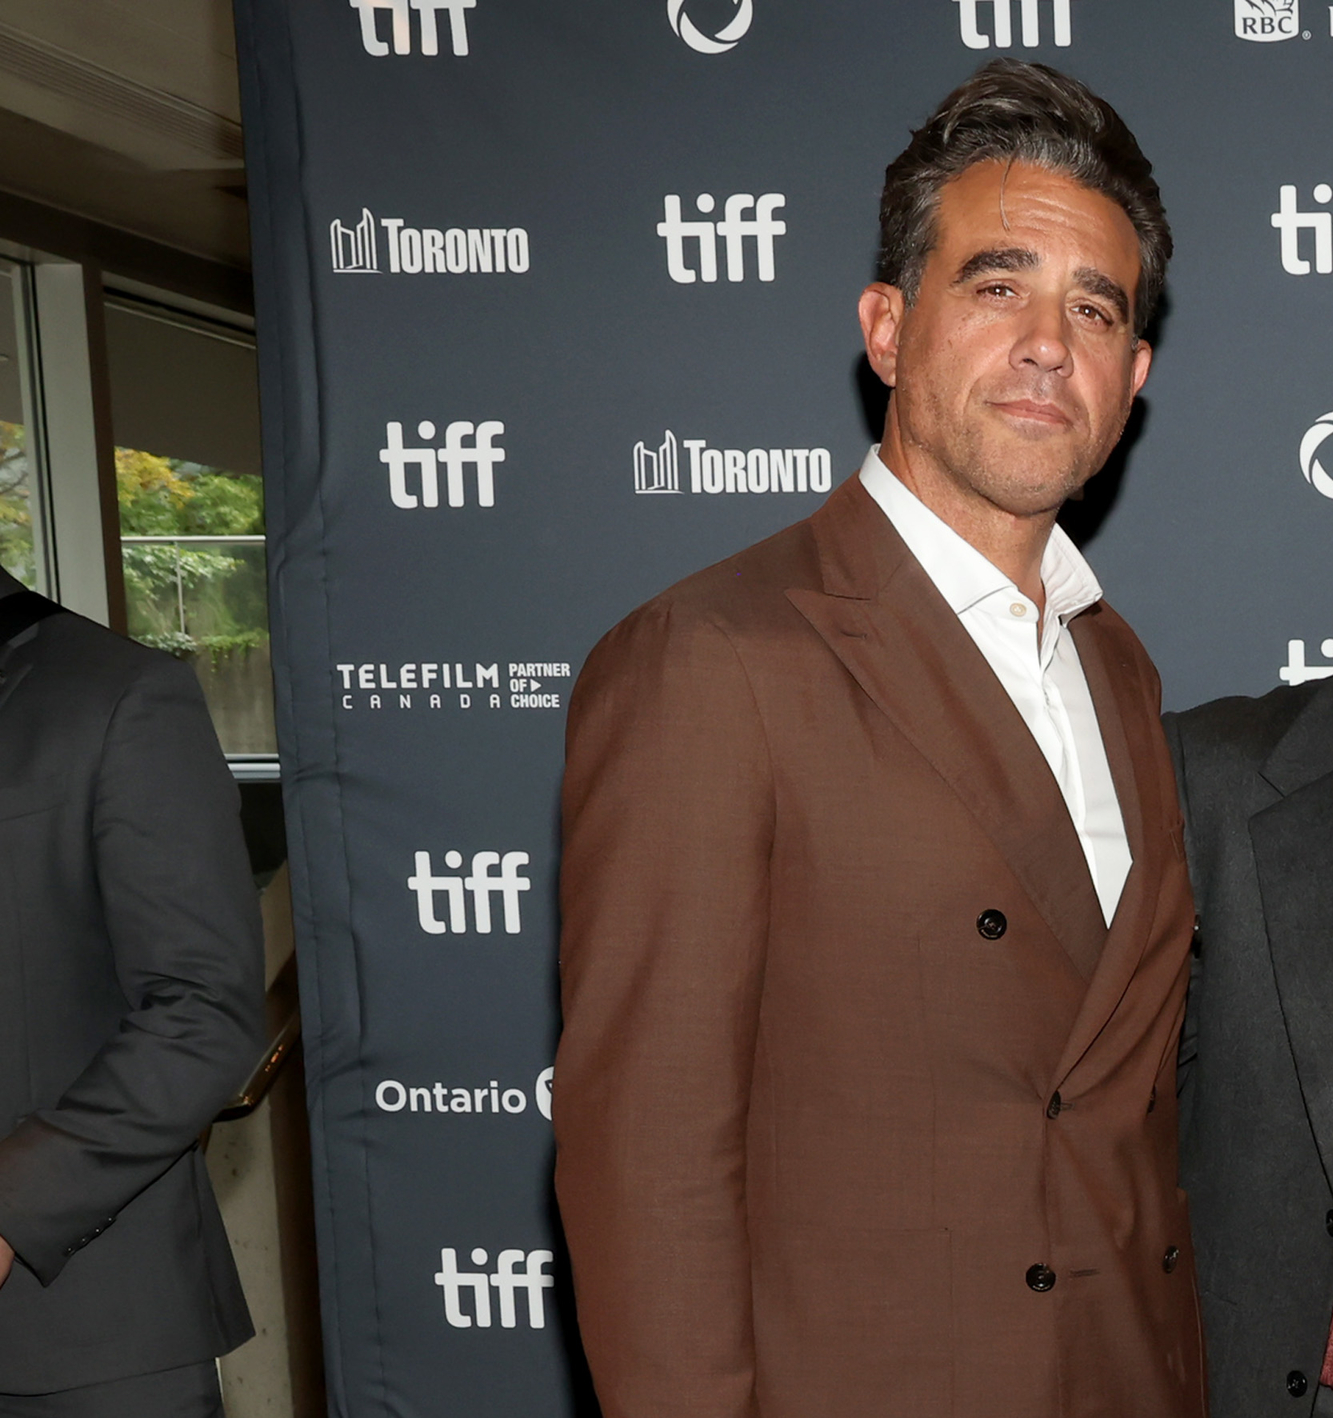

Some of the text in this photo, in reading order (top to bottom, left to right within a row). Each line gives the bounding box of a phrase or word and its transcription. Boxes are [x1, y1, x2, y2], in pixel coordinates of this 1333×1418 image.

[1242, 16, 1292, 35] RBC
[380, 218, 530, 274] TORONTO
[656, 193, 787, 284] tiff
[379, 420, 506, 509] tiff
[683, 439, 832, 494] TORONTO
[336, 663, 500, 689] TELEFILM
[508, 662, 571, 677] PARTNER
[509, 679, 528, 693] OF
[342, 693, 501, 709] CANADA
[510, 694, 560, 708] CHOICE
[407, 850, 531, 935] tiff
[375, 1080, 527, 1114] Ontario
[434, 1247, 553, 1329] tiff
